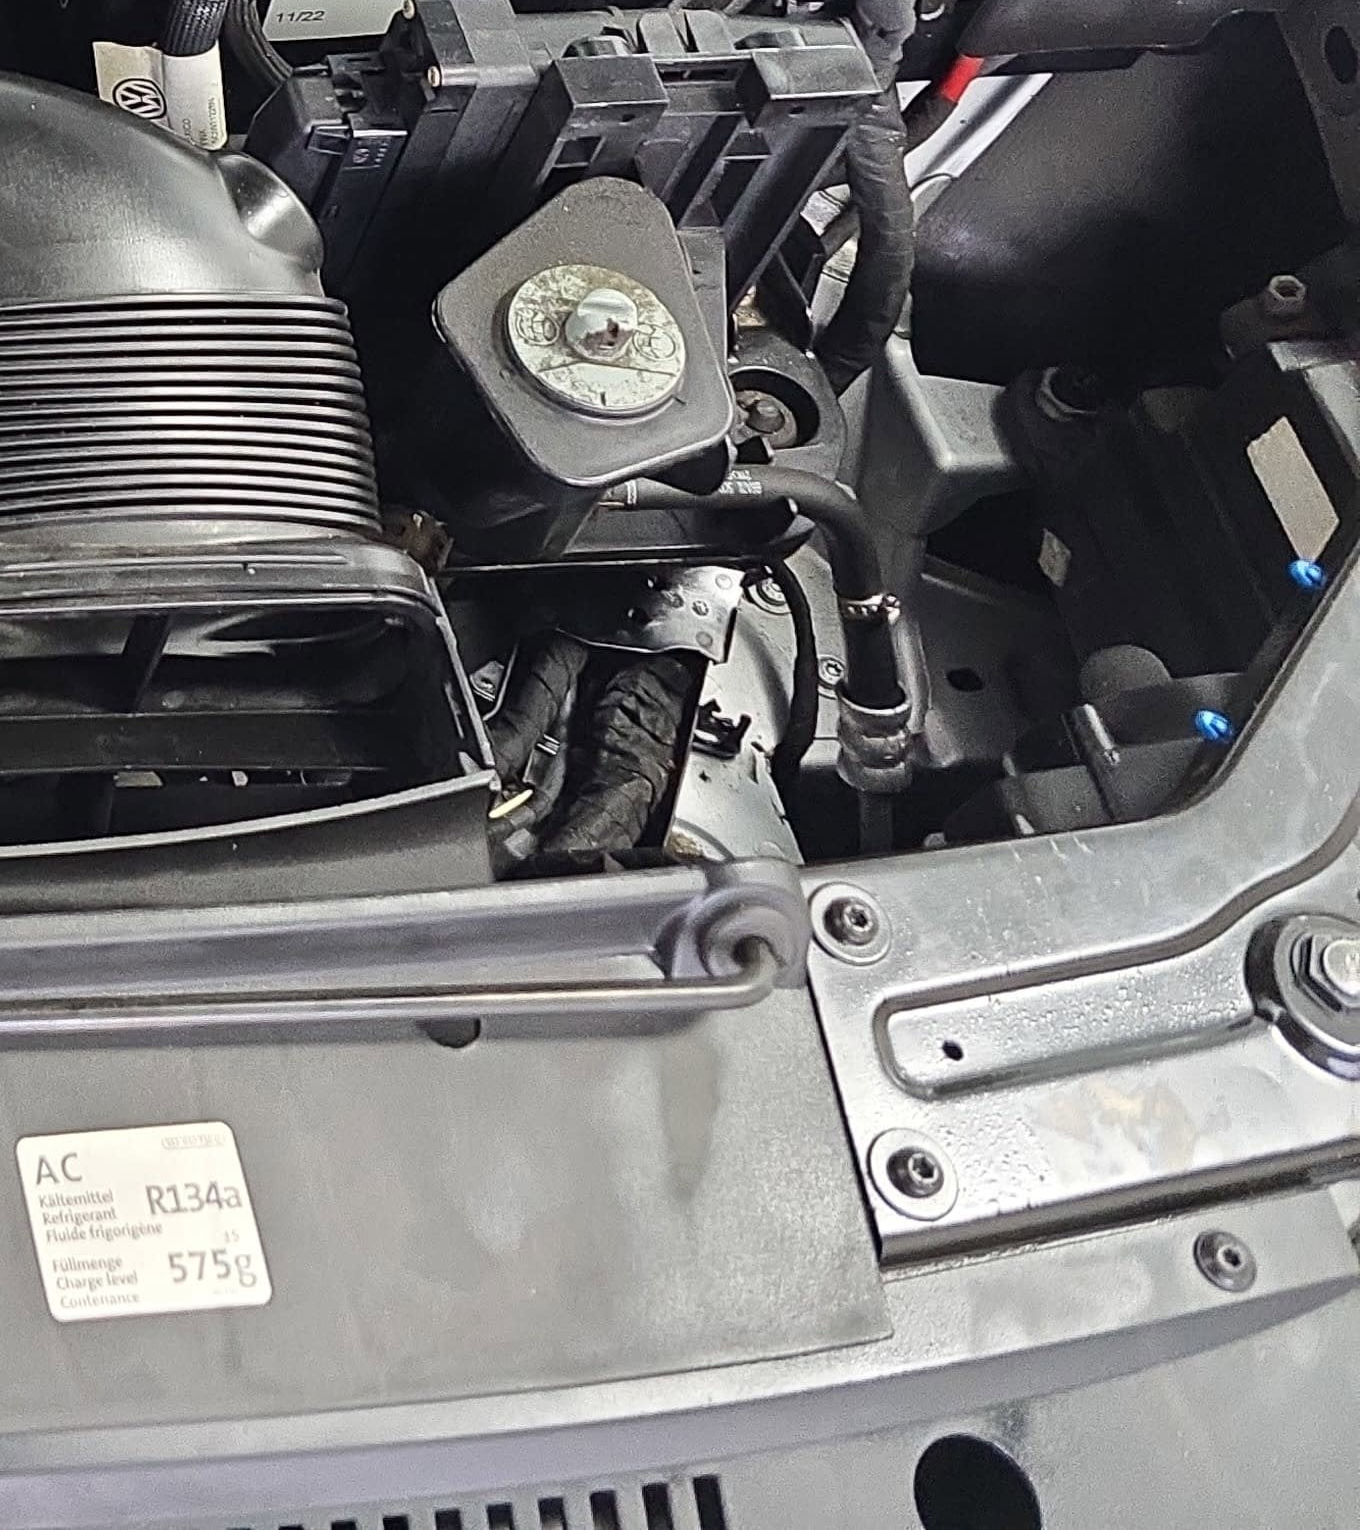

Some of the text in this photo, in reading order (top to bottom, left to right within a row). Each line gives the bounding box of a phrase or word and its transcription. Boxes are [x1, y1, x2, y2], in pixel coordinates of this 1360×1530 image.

[276, 10, 325, 22] 11/22
[35, 1151, 83, 1186] AC
[38, 1189, 116, 1209] Kältemittel
[145, 1179, 243, 1216] R134a
[42, 1207, 118, 1227] Refrigerant
[46, 1221, 164, 1244] Fluide frigorigène
[52, 1254, 124, 1274] Füllmenge
[167, 1247, 258, 1288] 575g
[56, 1271, 139, 1293] Charge level
[60, 1292, 141, 1310] Contenance
